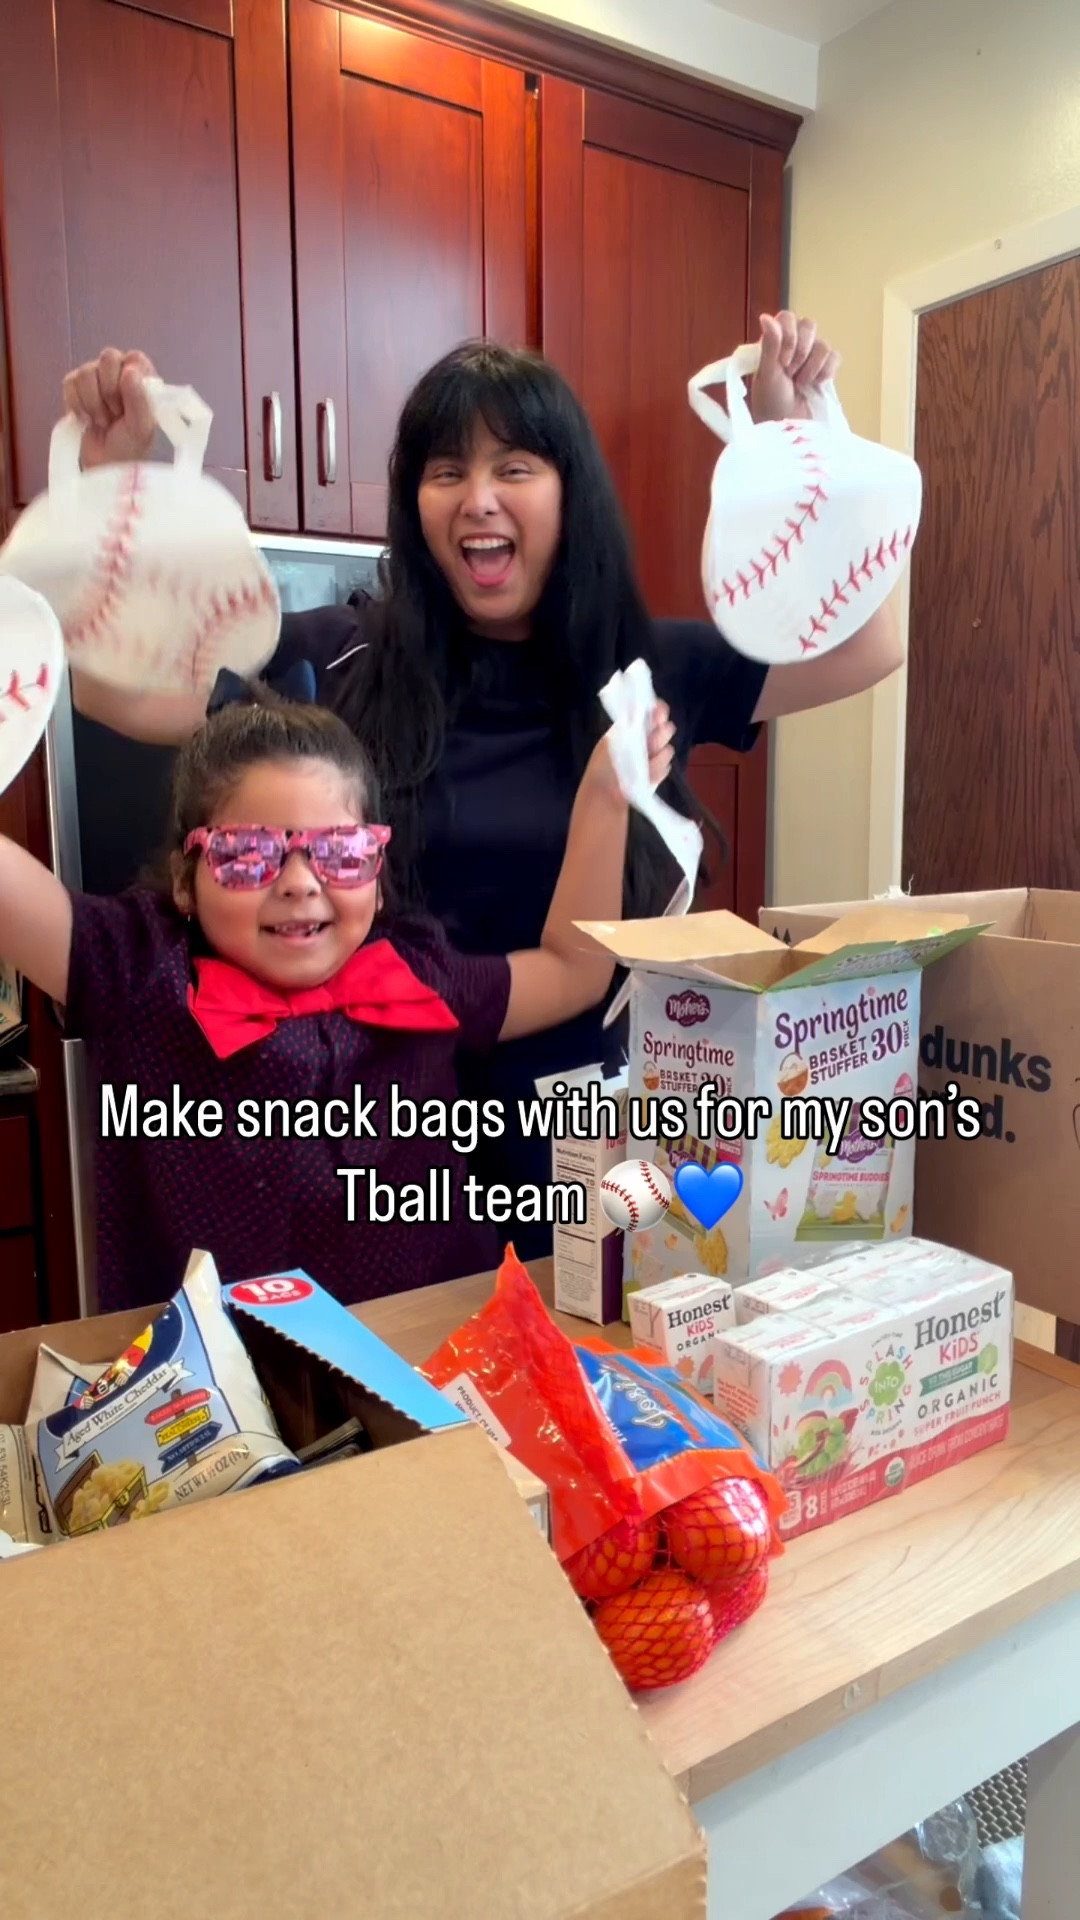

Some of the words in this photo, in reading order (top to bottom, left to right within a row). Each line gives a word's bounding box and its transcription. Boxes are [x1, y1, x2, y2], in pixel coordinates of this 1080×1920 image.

[775, 987, 908, 1060] Springtime
[643, 1031, 734, 1068] Springtime
[809, 1036, 867, 1070] BASKET
[871, 1022, 902, 1062] 30
[920, 1025, 1051, 1092] dunks
[660, 1070, 698, 1082] BASKET
[660, 1082, 698, 1093] STUFFER
[810, 1052, 869, 1085] STUFFER
[240, 1279, 295, 1297] 10
[668, 1294, 732, 1329] Honest
[914, 1291, 1006, 1350] Honest
[860, 1344, 913, 1385] SPLASH
[874, 1375, 899, 1393] INTO
[67, 1422, 92, 1446] Aged
[91, 1400, 125, 1426] White
[125, 1369, 169, 1403] Cheddar
[456, 1385, 482, 1421] PRODUCT
[859, 1385, 912, 1424] SPRING
[914, 1417, 942, 1437] SUPER
[944, 1405, 968, 1426] FRUIT
[970, 1391, 1001, 1414] PUNCH
[918, 1373, 998, 1419] ORGANIC
[174, 1480, 194, 1501] NET
[193, 1474, 208, 1495] WT
[215, 1460, 231, 1479] OZ
[805, 1495, 818, 1519] 8
